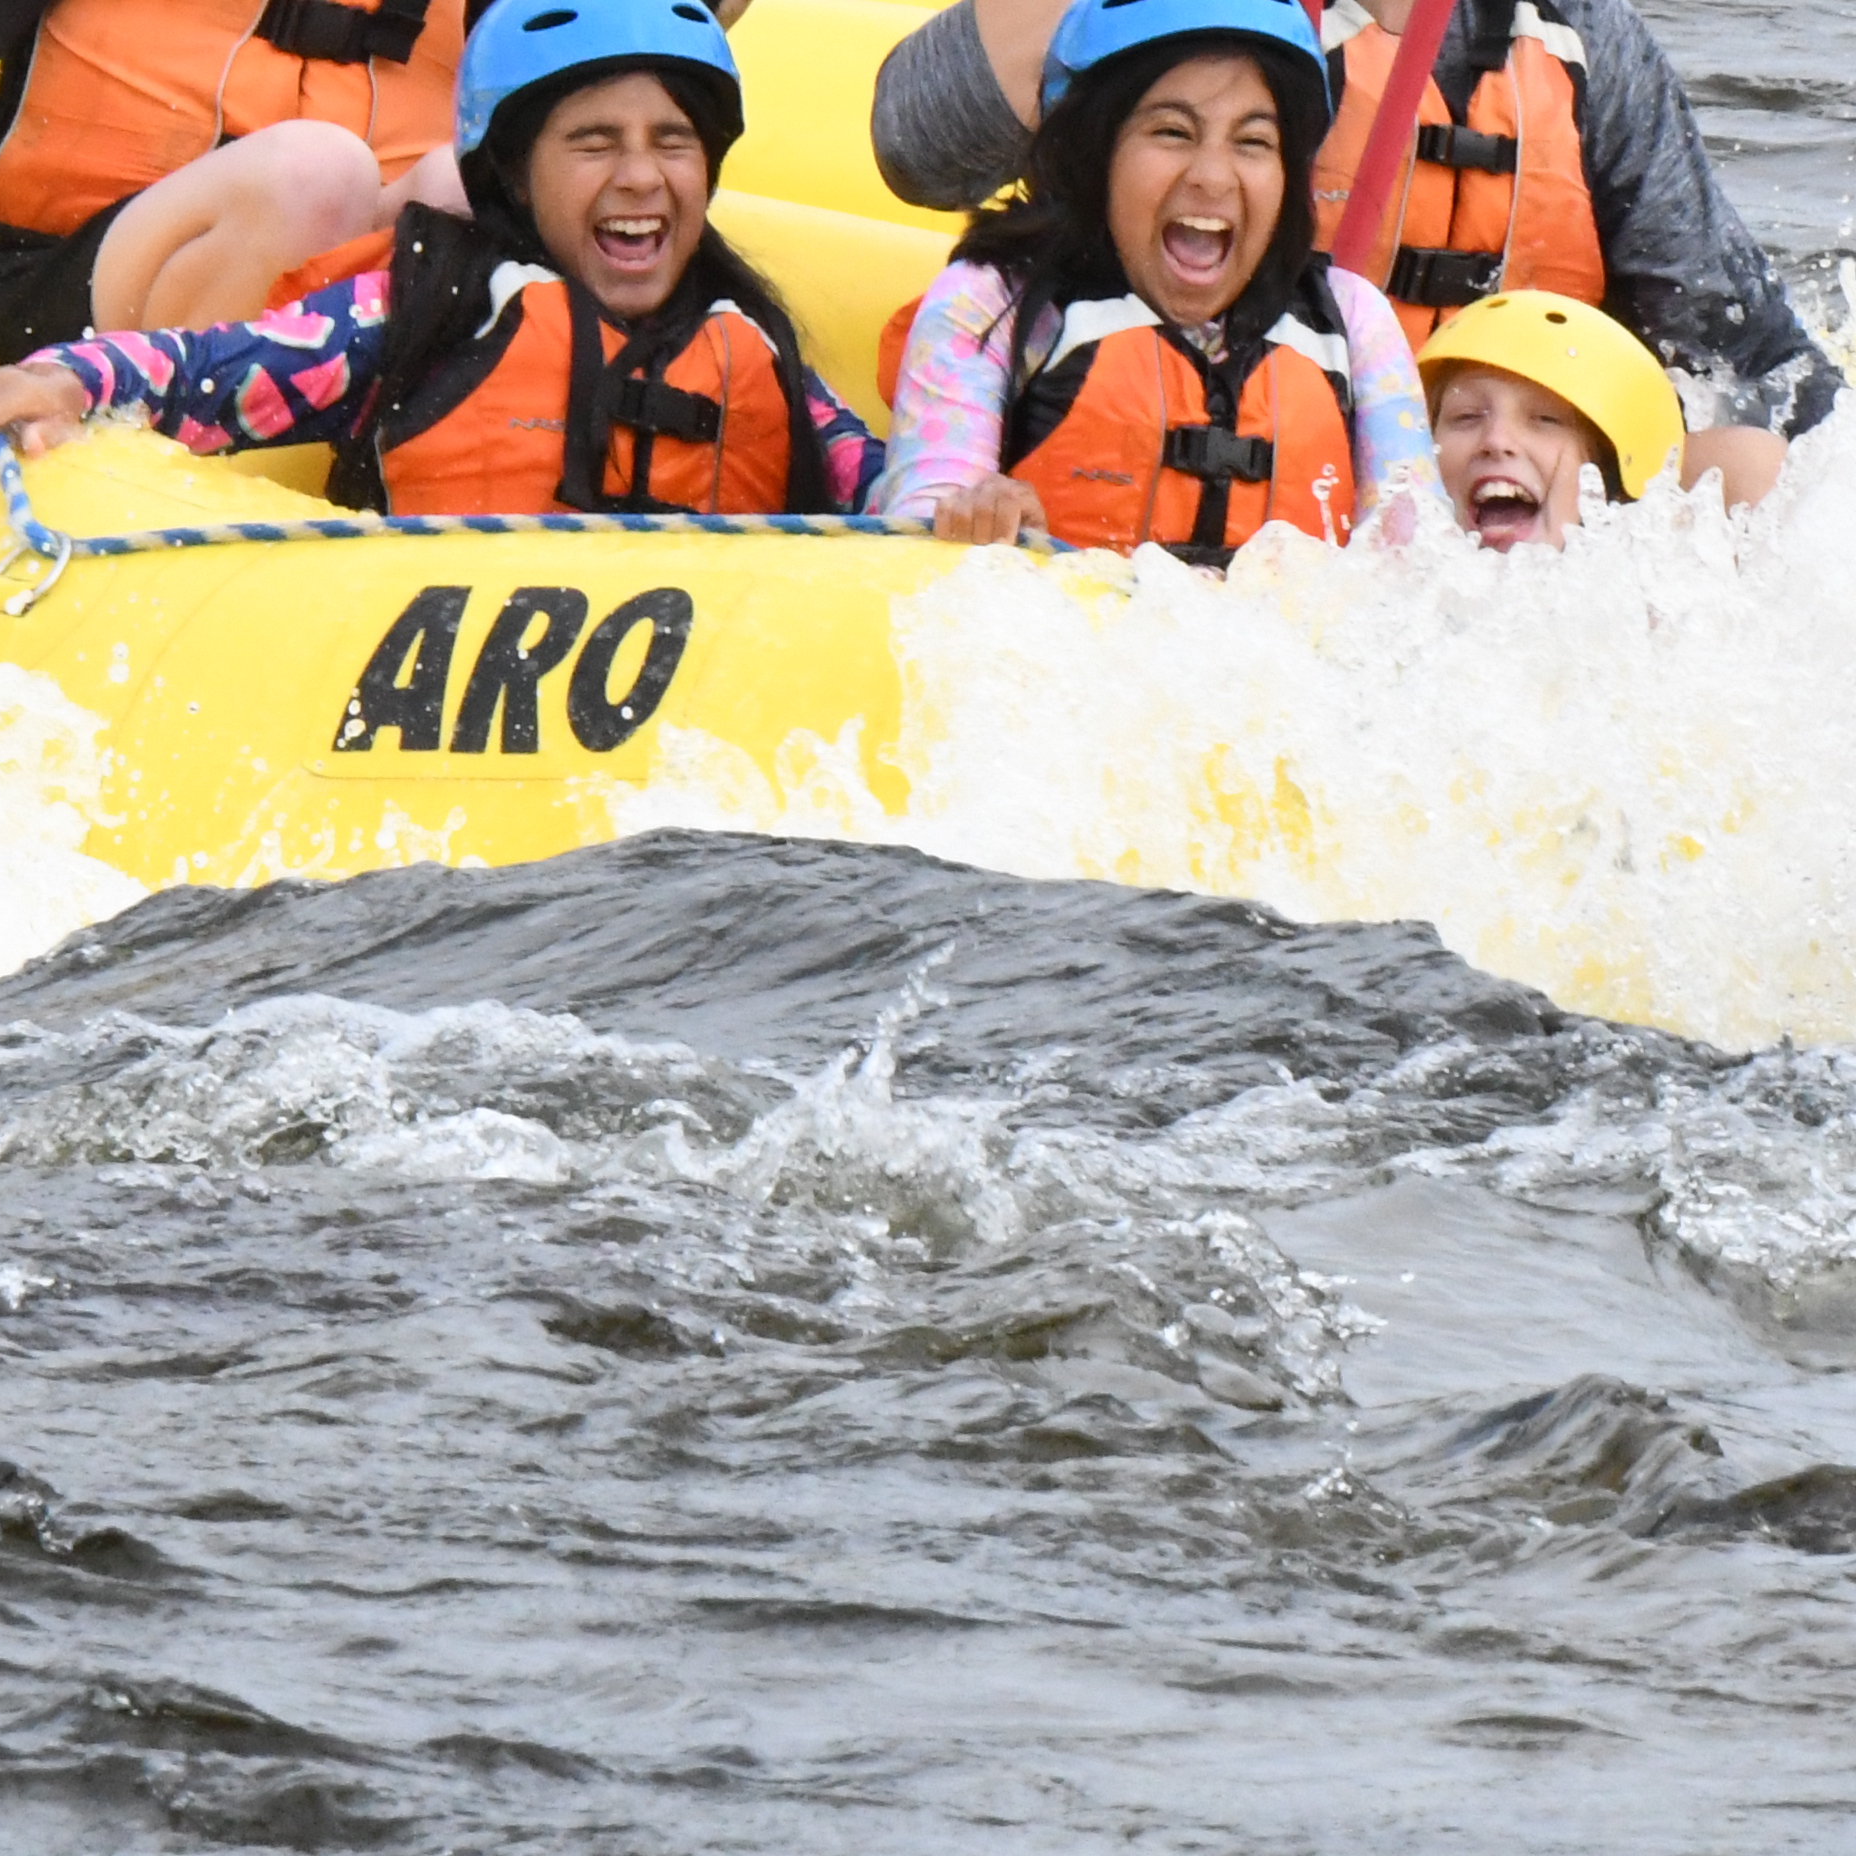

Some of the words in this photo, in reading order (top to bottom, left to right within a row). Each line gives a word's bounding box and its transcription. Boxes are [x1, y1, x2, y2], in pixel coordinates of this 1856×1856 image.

[1313, 189, 1350, 202] NR
[1071, 466, 1133, 486] NRS
[331, 585, 694, 754] ARO
